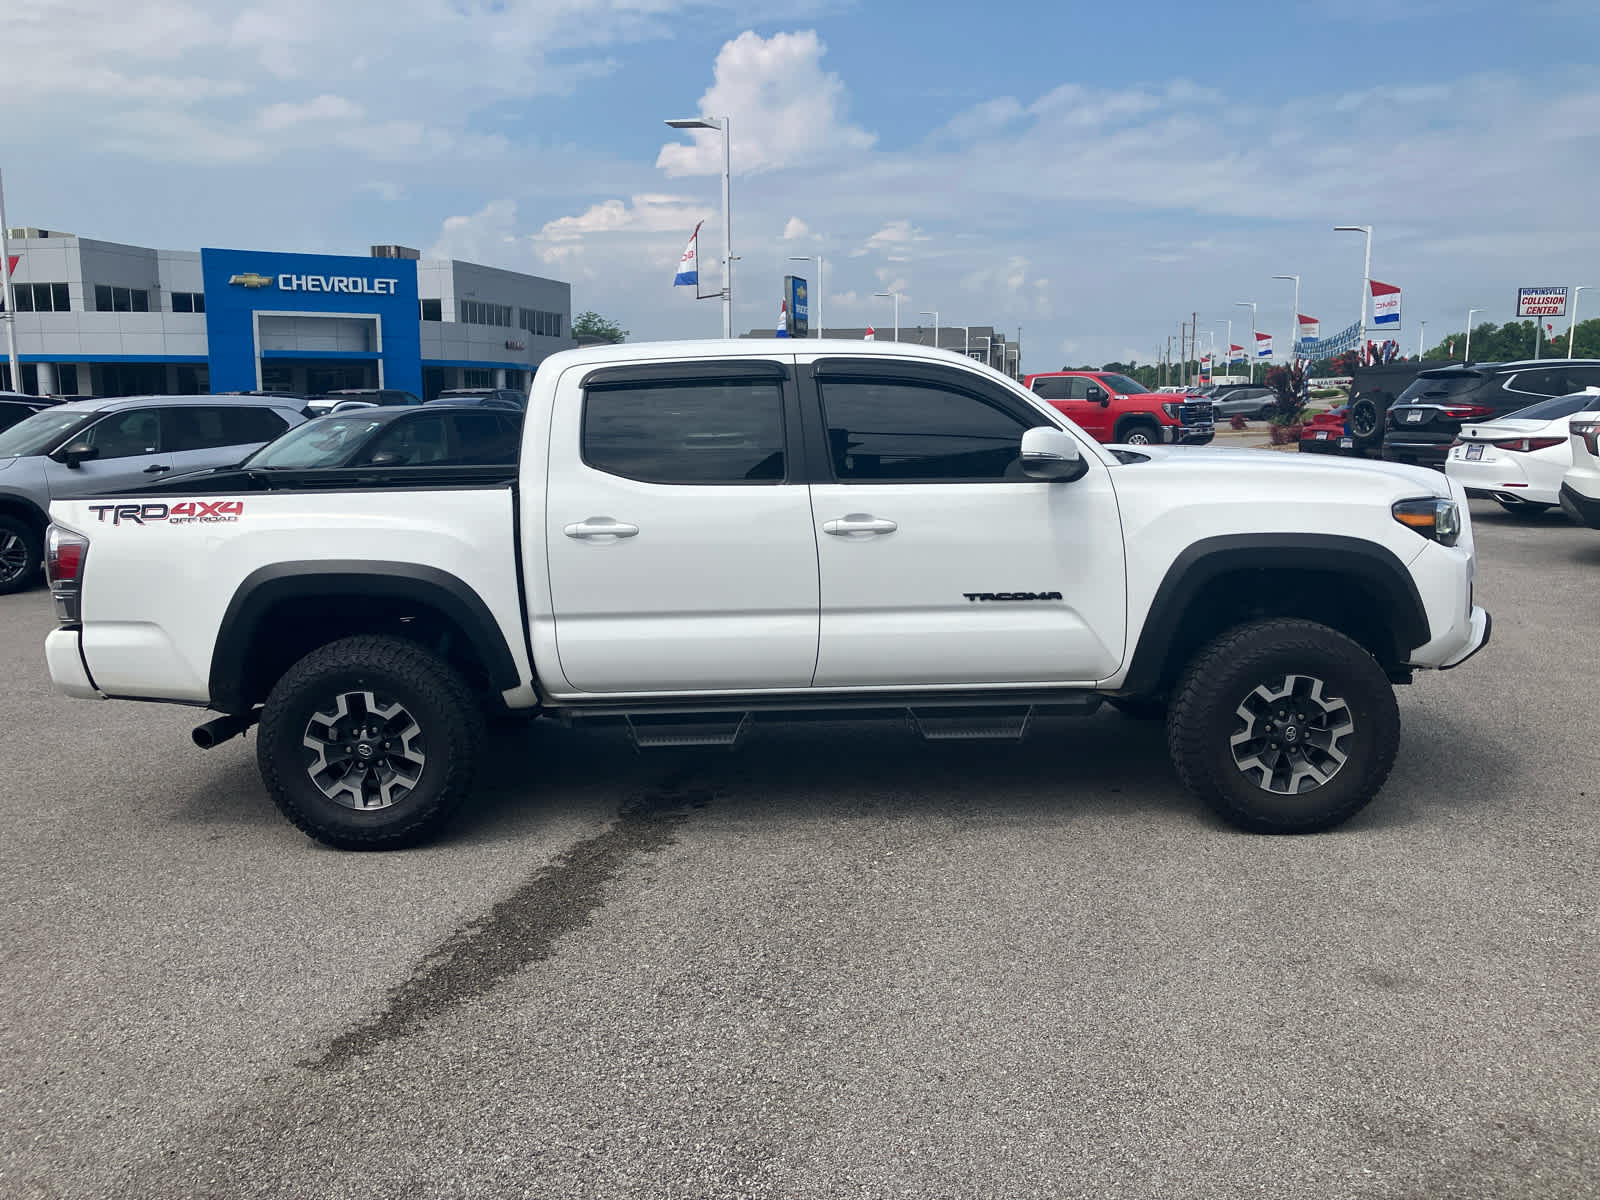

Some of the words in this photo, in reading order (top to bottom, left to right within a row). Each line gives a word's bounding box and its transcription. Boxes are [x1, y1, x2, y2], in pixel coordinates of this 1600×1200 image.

[278, 273, 398, 295] CHEVROLET
[1522, 288, 1566, 296] HOPKINSVILLE
[1521, 296, 1564, 305] COLLISION
[1526, 306, 1558, 315] CENTER
[88, 503, 170, 526] TRD
[169, 517, 196, 525] OFF
[198, 516, 239, 524] ROAD
[962, 591, 1063, 602] TACOMA
